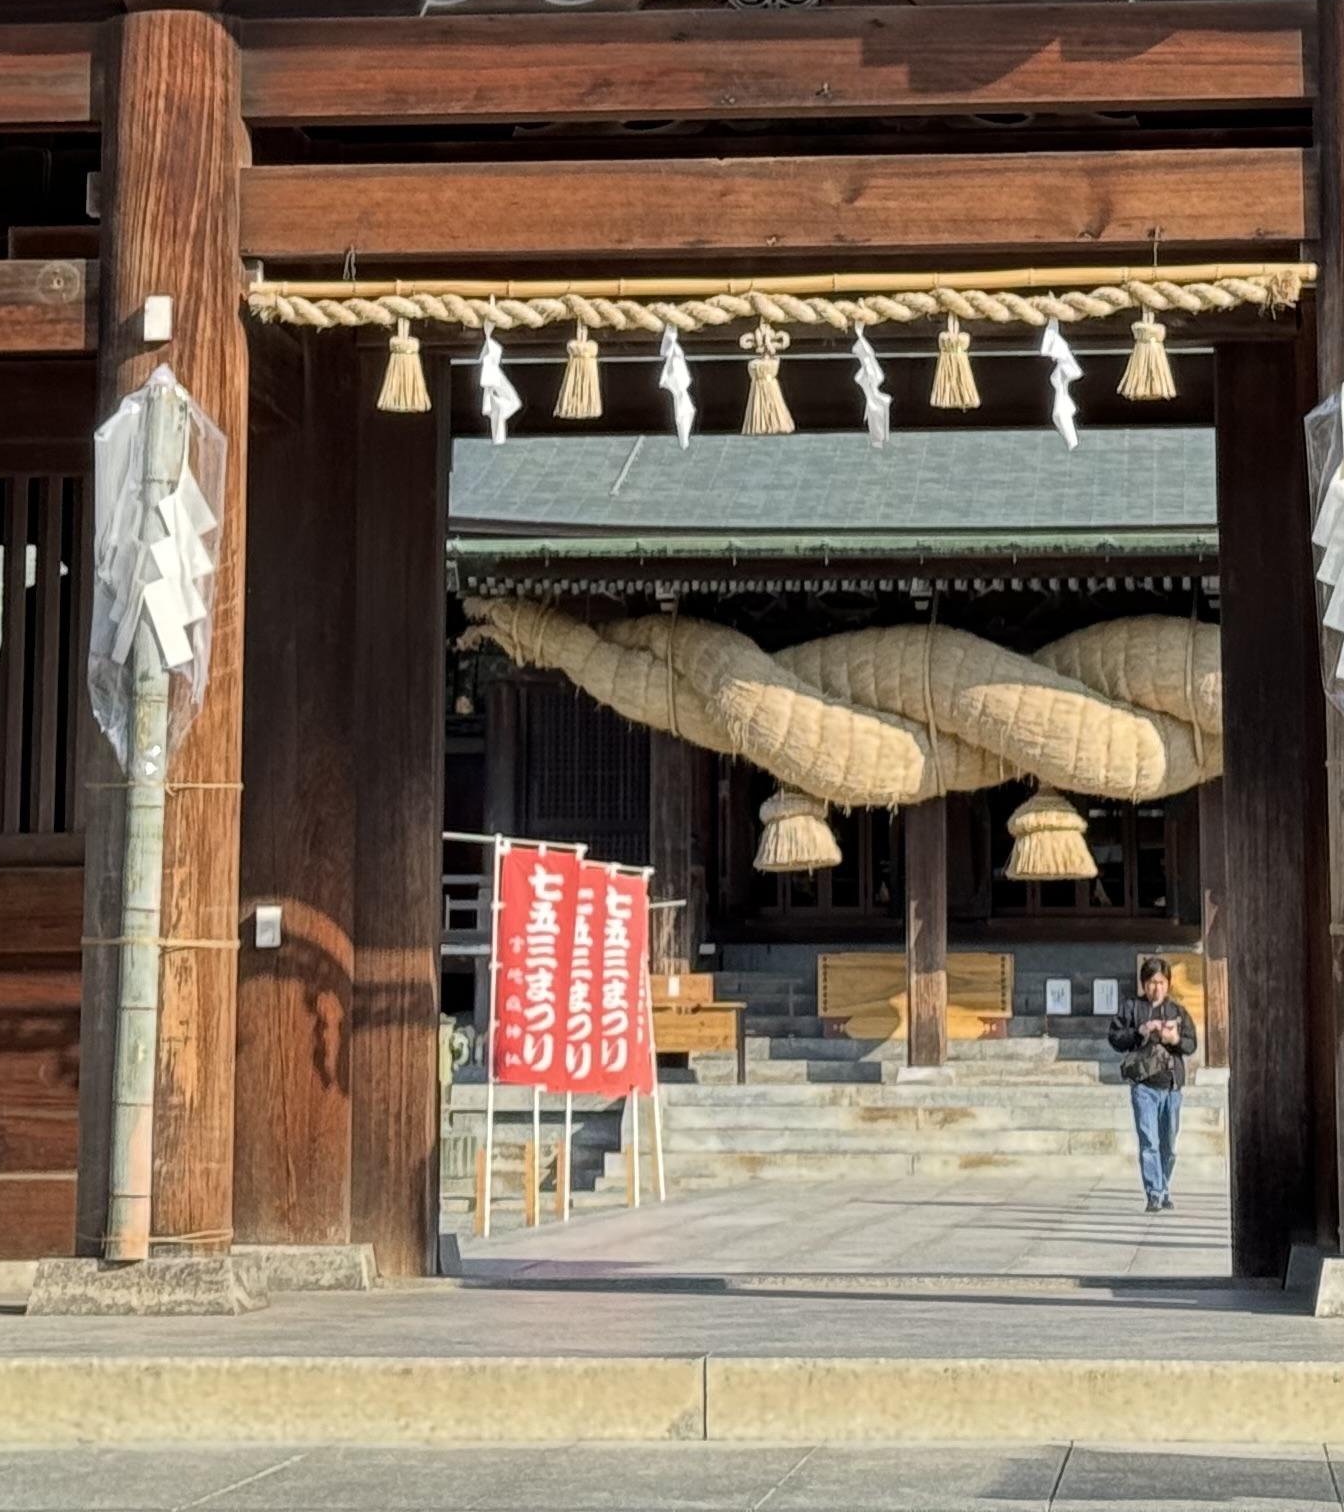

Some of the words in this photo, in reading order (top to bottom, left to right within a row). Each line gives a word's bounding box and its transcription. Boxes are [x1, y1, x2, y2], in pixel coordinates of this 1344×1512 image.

[523, 863, 564, 1072] 七五三まつり
[601, 884, 633, 1072] 七五三まつり
